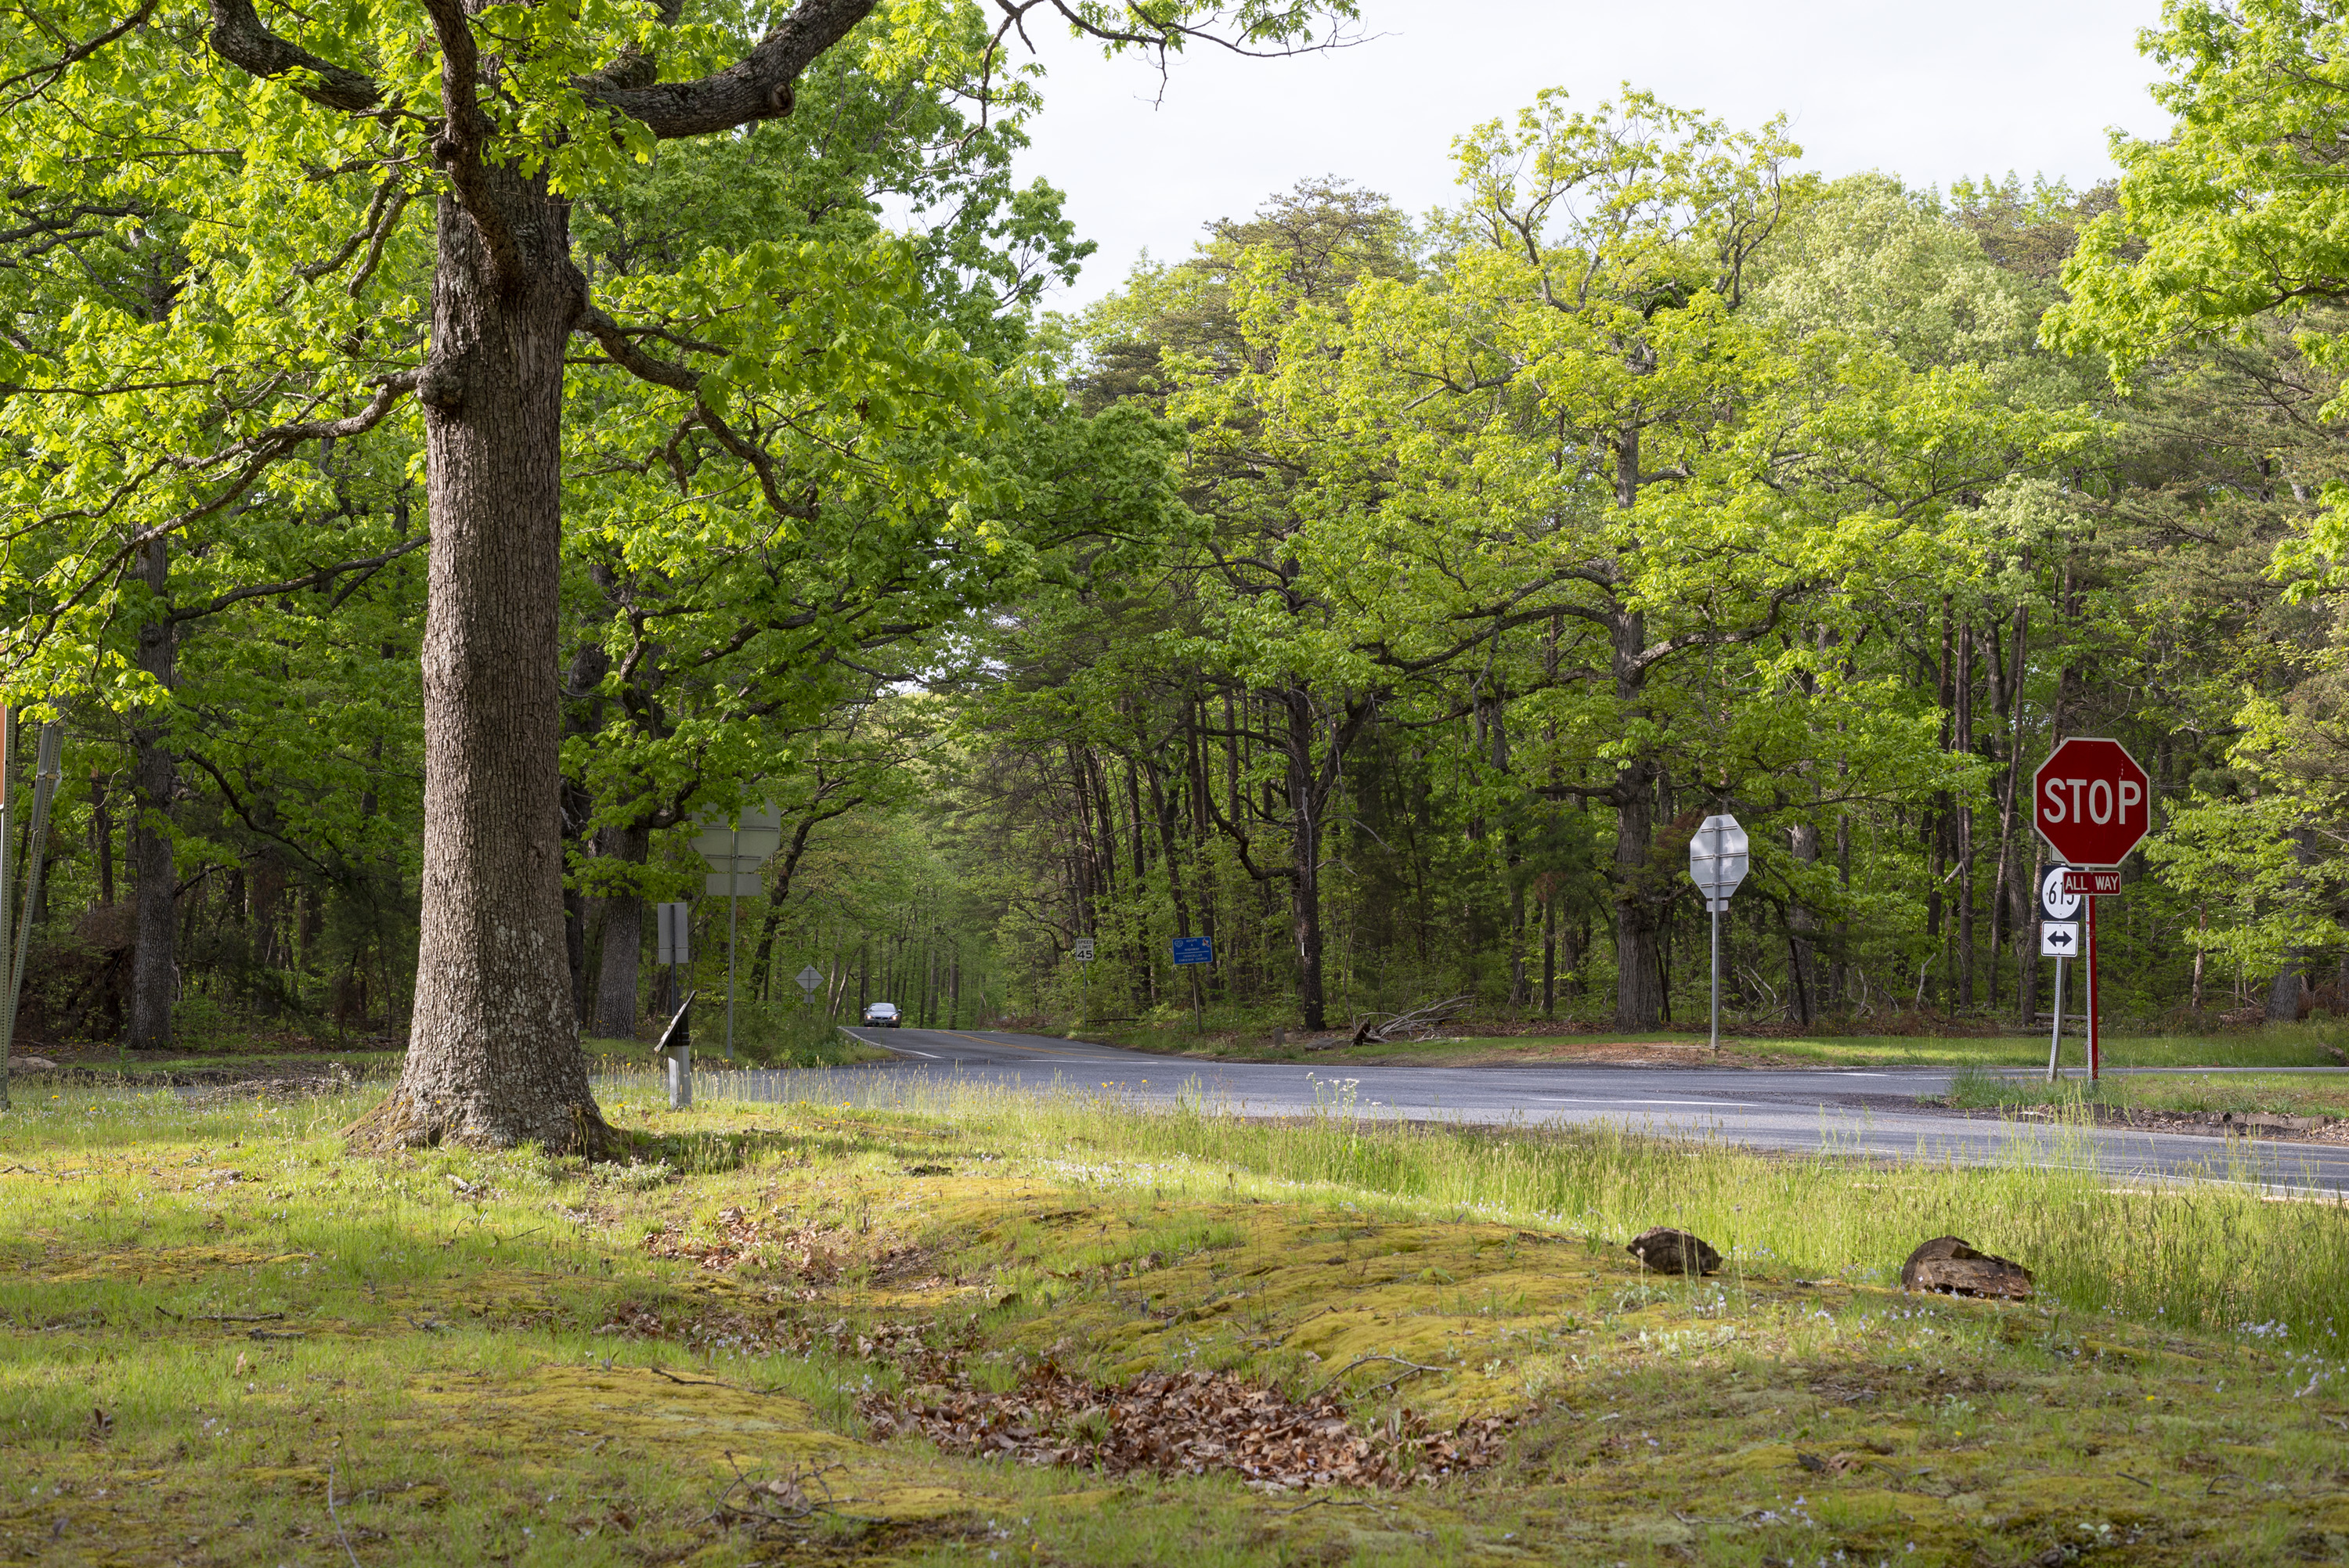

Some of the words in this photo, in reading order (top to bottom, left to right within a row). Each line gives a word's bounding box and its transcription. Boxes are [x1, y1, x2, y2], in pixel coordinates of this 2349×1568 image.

[2043, 777, 2142, 824] STOP
[2065, 875, 2088, 890] ALL
[2095, 875, 2119, 890] WAY
[1077, 950, 1093, 959] 45
